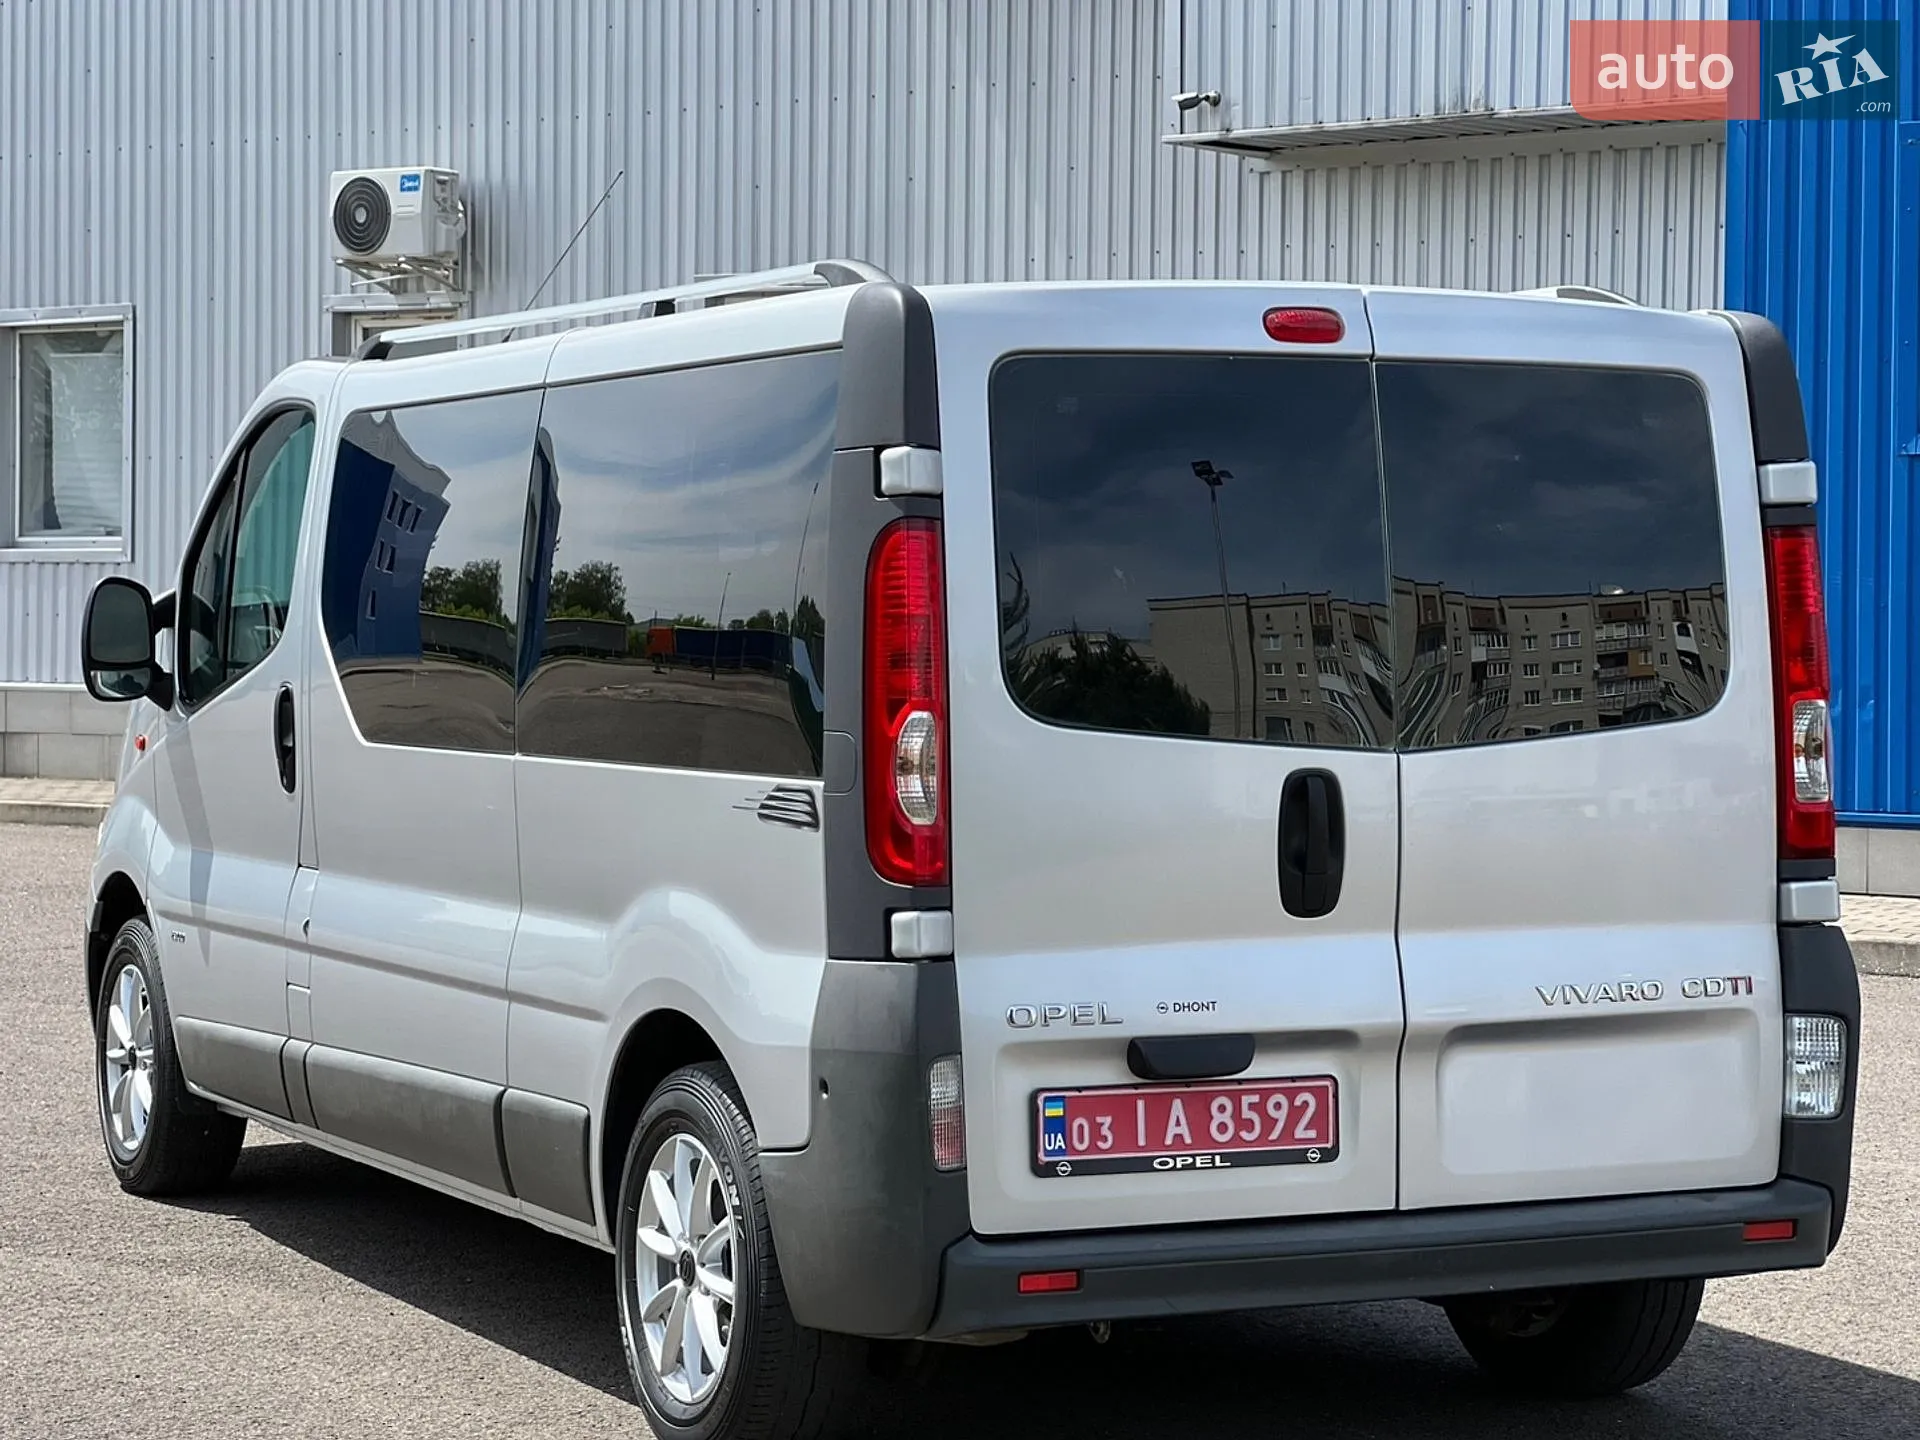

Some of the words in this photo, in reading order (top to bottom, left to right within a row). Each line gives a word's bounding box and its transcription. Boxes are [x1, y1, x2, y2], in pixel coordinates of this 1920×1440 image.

[1535, 979, 1664, 1006] VIVARO
[1680, 975, 1755, 999] CDTI
[1005, 1001, 1124, 1028] OPEL
[1172, 1001, 1218, 1013] DHONT
[1071, 1115, 1114, 1151] 03
[1209, 1092, 1317, 1143] 8592
[1044, 1133, 1066, 1151] UA
[1152, 1154, 1232, 1170] OPEL
